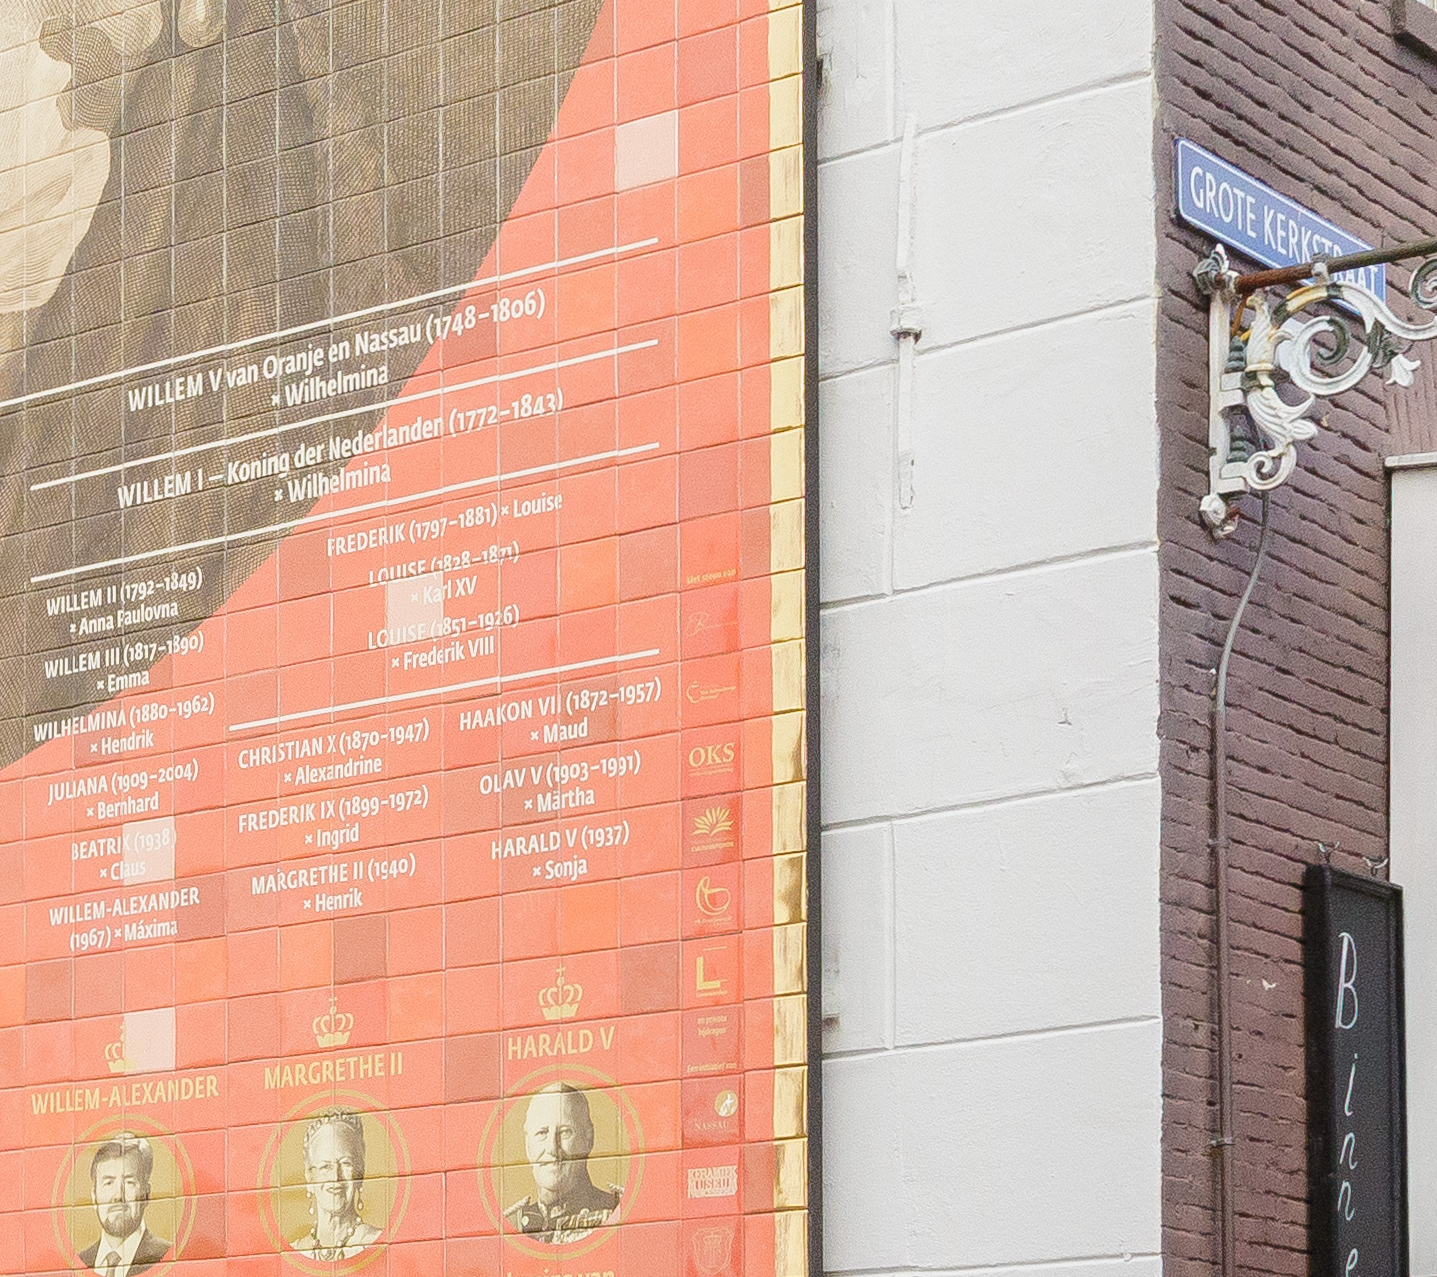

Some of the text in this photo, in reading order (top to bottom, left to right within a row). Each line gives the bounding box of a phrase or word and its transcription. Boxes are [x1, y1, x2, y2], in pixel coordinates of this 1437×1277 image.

[1190, 166, 1257, 239] GROTE
[128, 372, 204, 414] WILLEM
[207, 366, 224, 395] V
[225, 362, 258, 390] van
[262, 344, 325, 381] Oranje
[329, 339, 350, 365] en
[354, 324, 422, 359] Nassau
[284, 364, 388, 408] Wilhelmina
[117, 469, 192, 510] WILLEM
[196, 467, 204, 492] I
[227, 451, 289, 483] Koning
[293, 443, 324, 470] der
[328, 416, 442, 463] Nederlanden
[287, 462, 391, 505] Wilhelmina
[688, 738, 736, 769] OKS
[238, 802, 318, 834] FREDERIK
[320, 799, 335, 821] IX
[316, 821, 359, 848] Ingrid
[490, 818, 629, 861] HARALD V (1937)
[544, 854, 587, 880] Sonja
[314, 885, 363, 914] Henrik
[506, 1024, 615, 1062] HARALD V
[263, 1050, 402, 1091] MARGRETHE II
[31, 1071, 219, 1118] WILLEM-ALEXANDER
